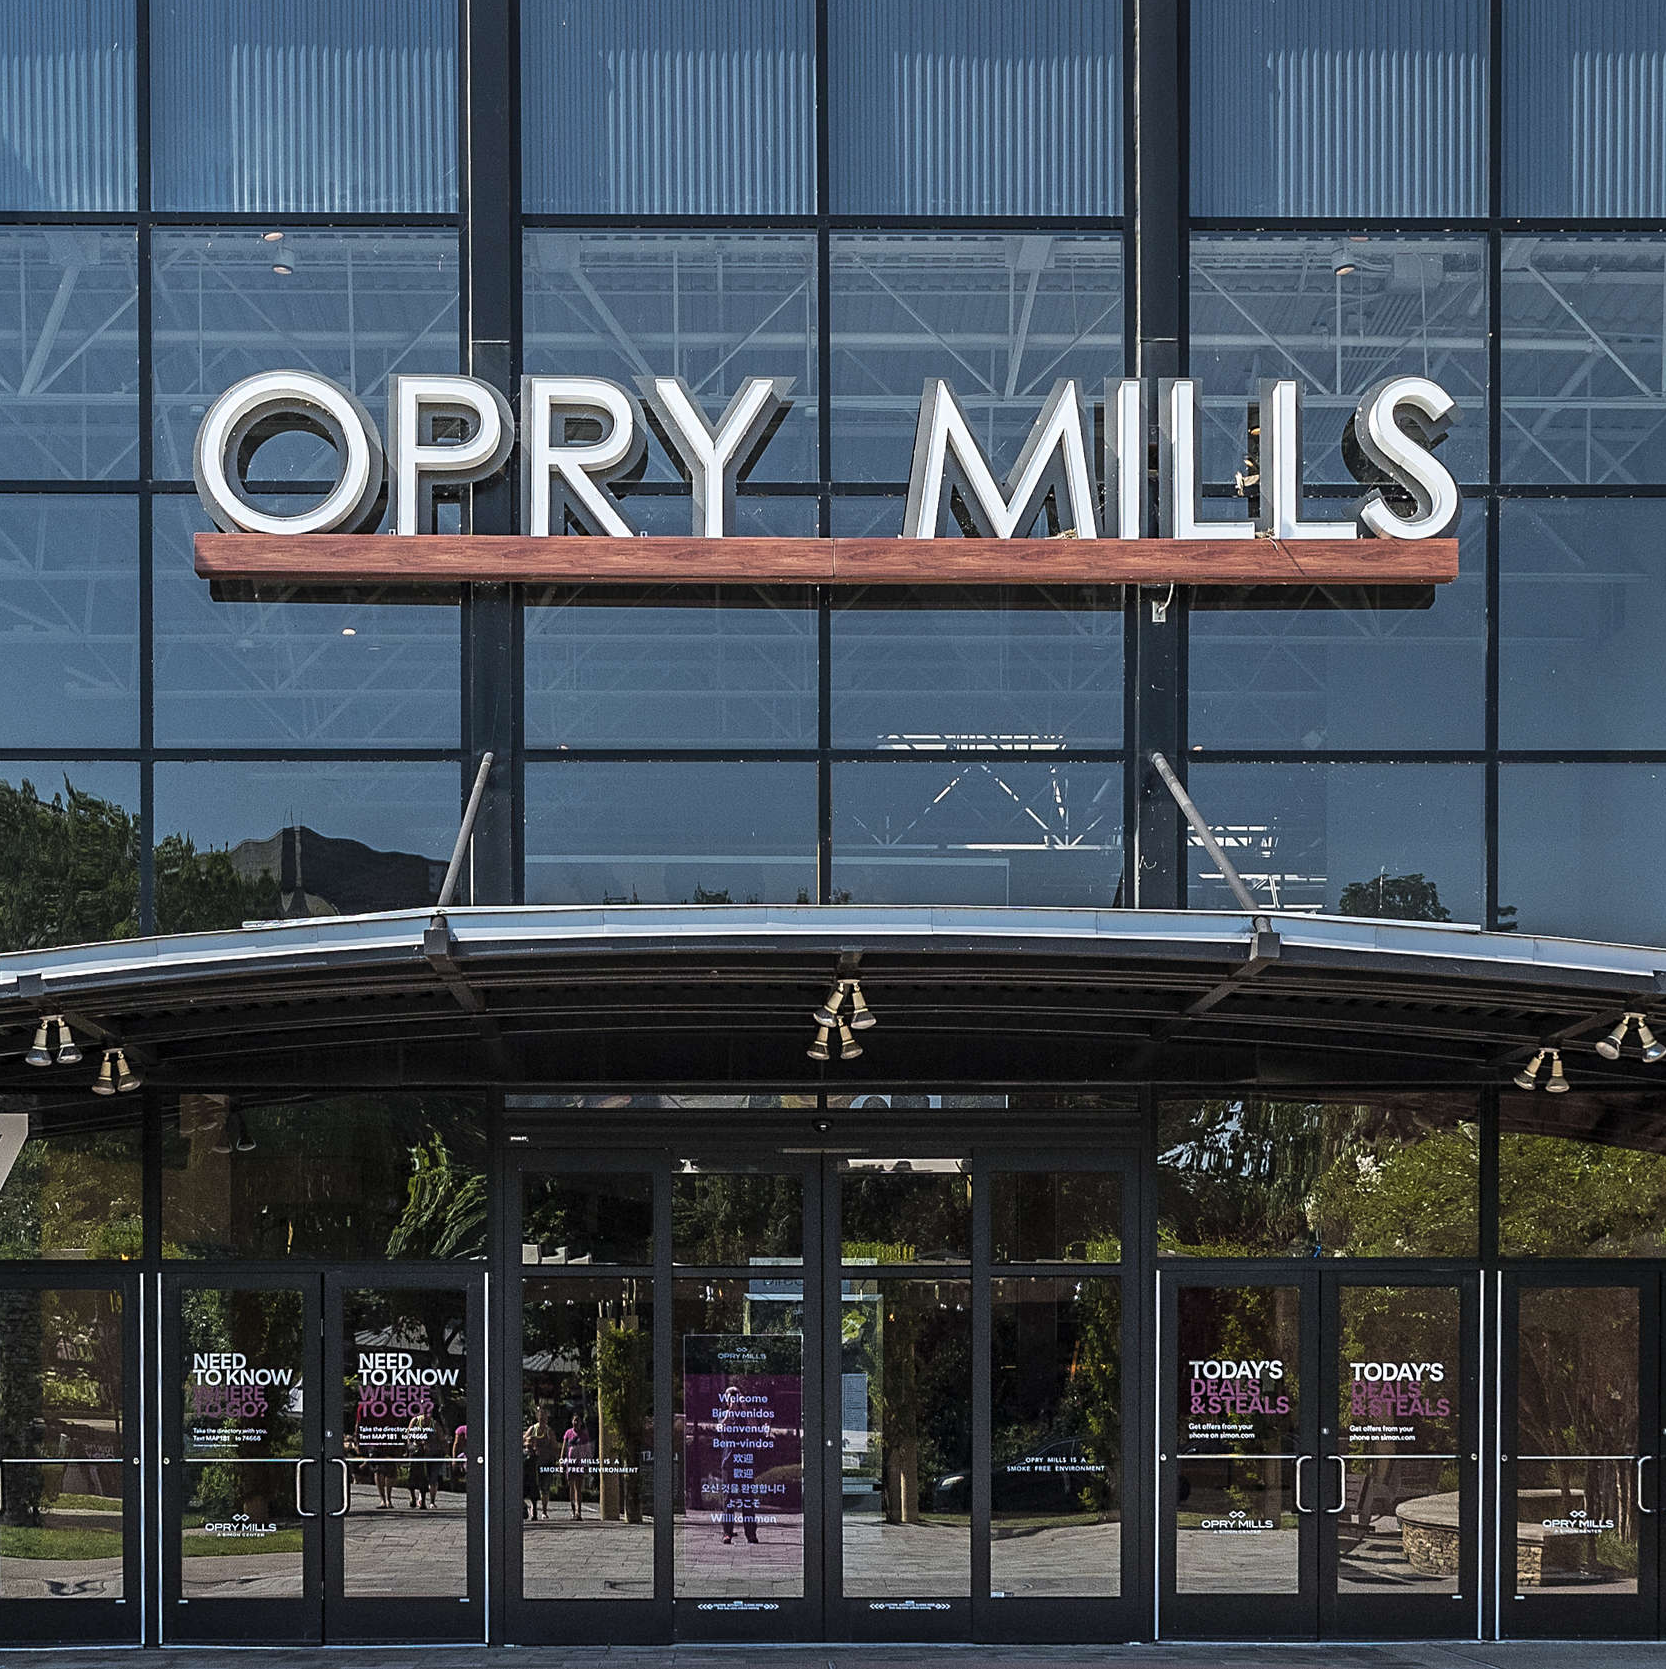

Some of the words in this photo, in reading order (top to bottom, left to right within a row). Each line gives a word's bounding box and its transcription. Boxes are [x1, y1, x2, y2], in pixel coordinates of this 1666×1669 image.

[197, 372, 783, 537] OPRY
[911, 375, 1459, 540] MILLS
[193, 1353, 247, 1369] NEED
[359, 1353, 413, 1369] NEED
[193, 1369, 222, 1385] TO
[226, 1369, 293, 1385] KNOW
[358, 1369, 388, 1385] TO
[392, 1369, 459, 1385] KNOW
[1189, 1360, 1283, 1379] TODAY'S
[1350, 1362, 1444, 1381] TODAY'S
[193, 1386, 265, 1401] WHERE
[359, 1386, 432, 1401] WHERE
[1191, 1379, 1260, 1396] DEALS
[1352, 1382, 1422, 1399] DEALS
[718, 1393, 768, 1403] Welcome
[193, 1401, 222, 1417] TO
[226, 1401, 269, 1417] GO?
[358, 1401, 388, 1417] TO
[391, 1401, 434, 1417] GO?
[711, 1408, 775, 1418] Bienvenidos
[1239, 1424, 1253, 1432] your
[712, 1438, 774, 1448] Bem-vindos
[726, 1498, 760, 1509] ようこそ
[710, 1513, 777, 1524] Willkommen
[1201, 1520, 1236, 1529] OPRY
[1238, 1520, 1274, 1529] MILLS
[1542, 1519, 1577, 1528] OPRY
[1579, 1519, 1614, 1528] MILLS
[205, 1523, 240, 1532] OPRY
[242, 1523, 277, 1532] MILLS
